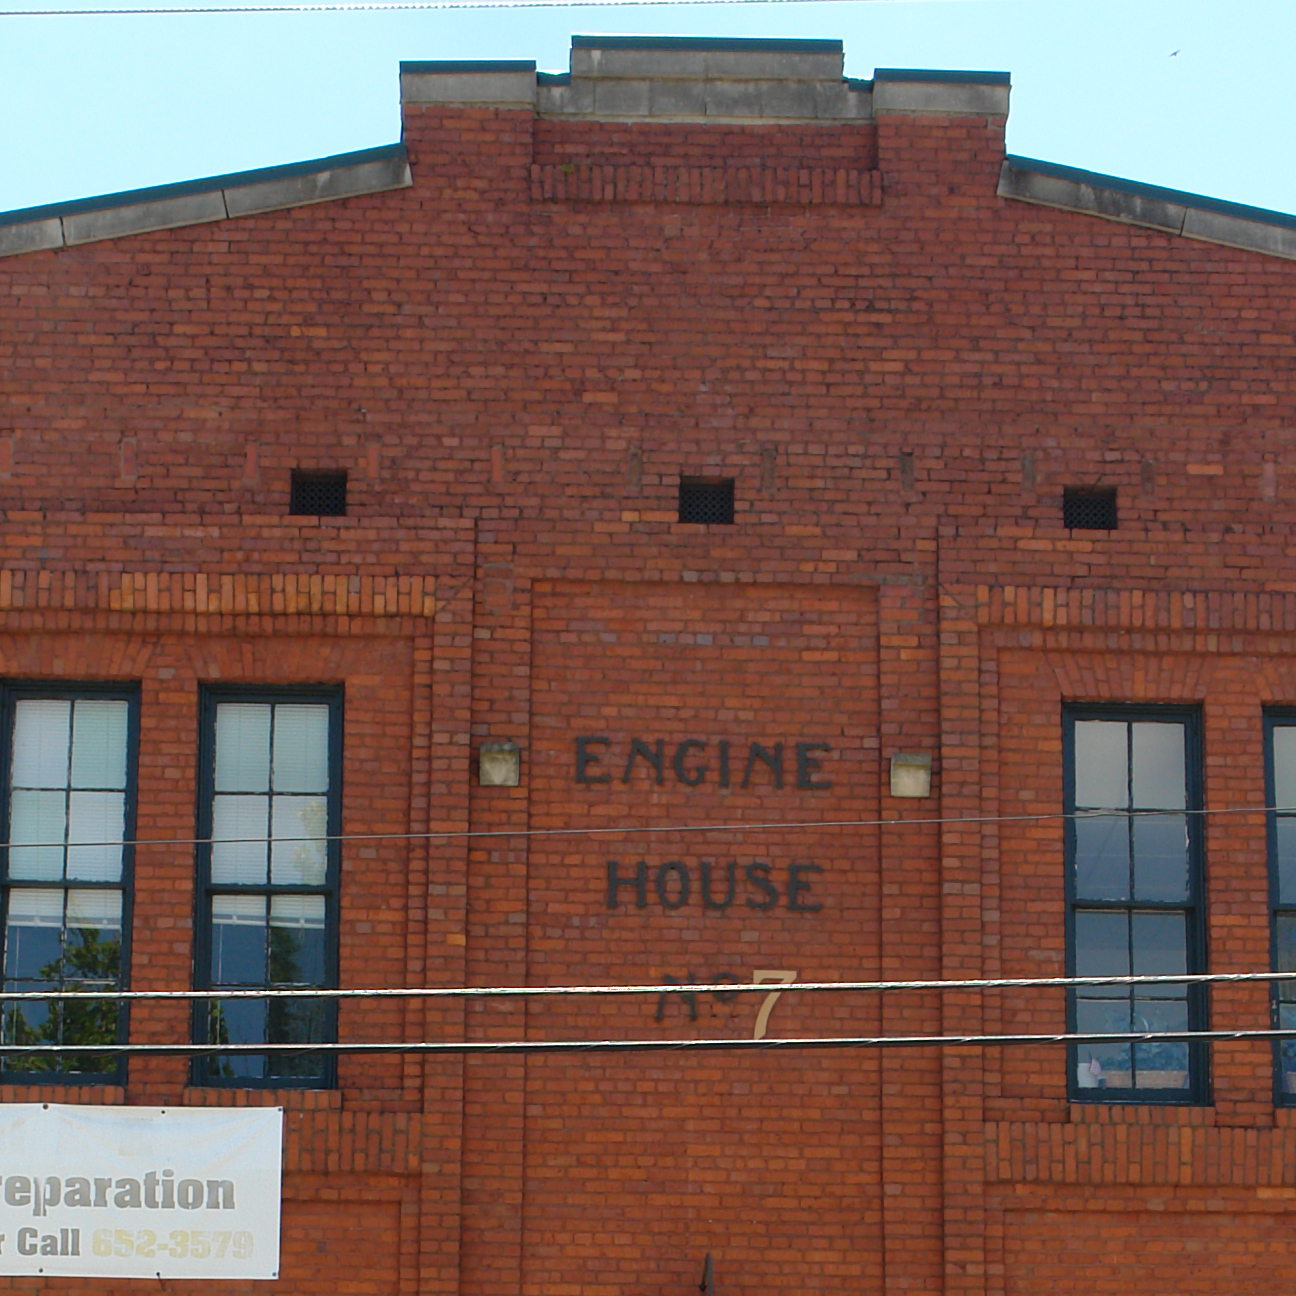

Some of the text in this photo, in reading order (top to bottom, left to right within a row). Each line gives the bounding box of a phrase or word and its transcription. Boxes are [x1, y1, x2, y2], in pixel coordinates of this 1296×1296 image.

[575, 737, 832, 789] ENGINE
[606, 861, 824, 912] HOUSE
[753, 970, 797, 1039] 7
[16, 1227, 81, 1257] Call
[91, 1229, 254, 1260] 652-3579
